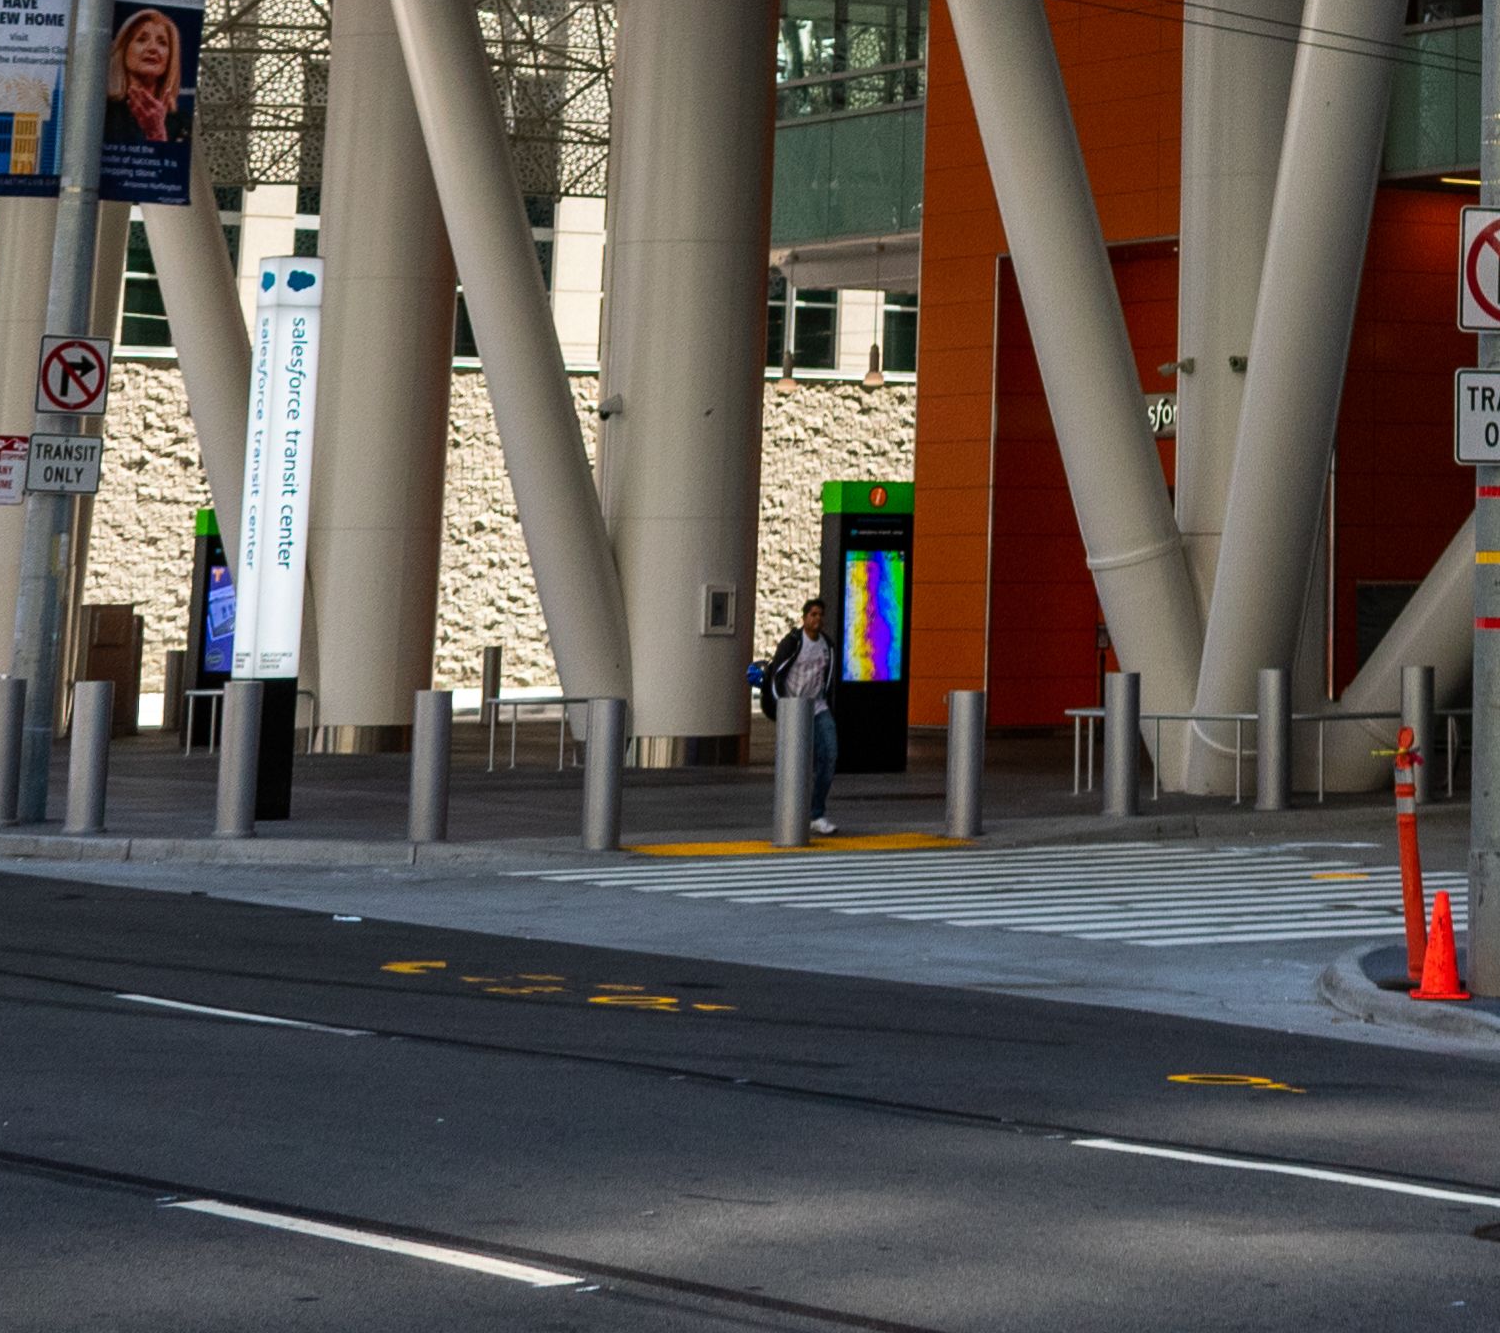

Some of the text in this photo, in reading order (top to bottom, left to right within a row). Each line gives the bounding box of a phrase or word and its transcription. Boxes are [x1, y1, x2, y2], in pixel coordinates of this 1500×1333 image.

[25, 13, 65, 27] HOME
[36, 443, 97, 462] TRANSIT
[246, 317, 270, 570] salesforce transit center
[278, 317, 308, 570] salesforce transit center
[43, 466, 84, 484] ONLY
